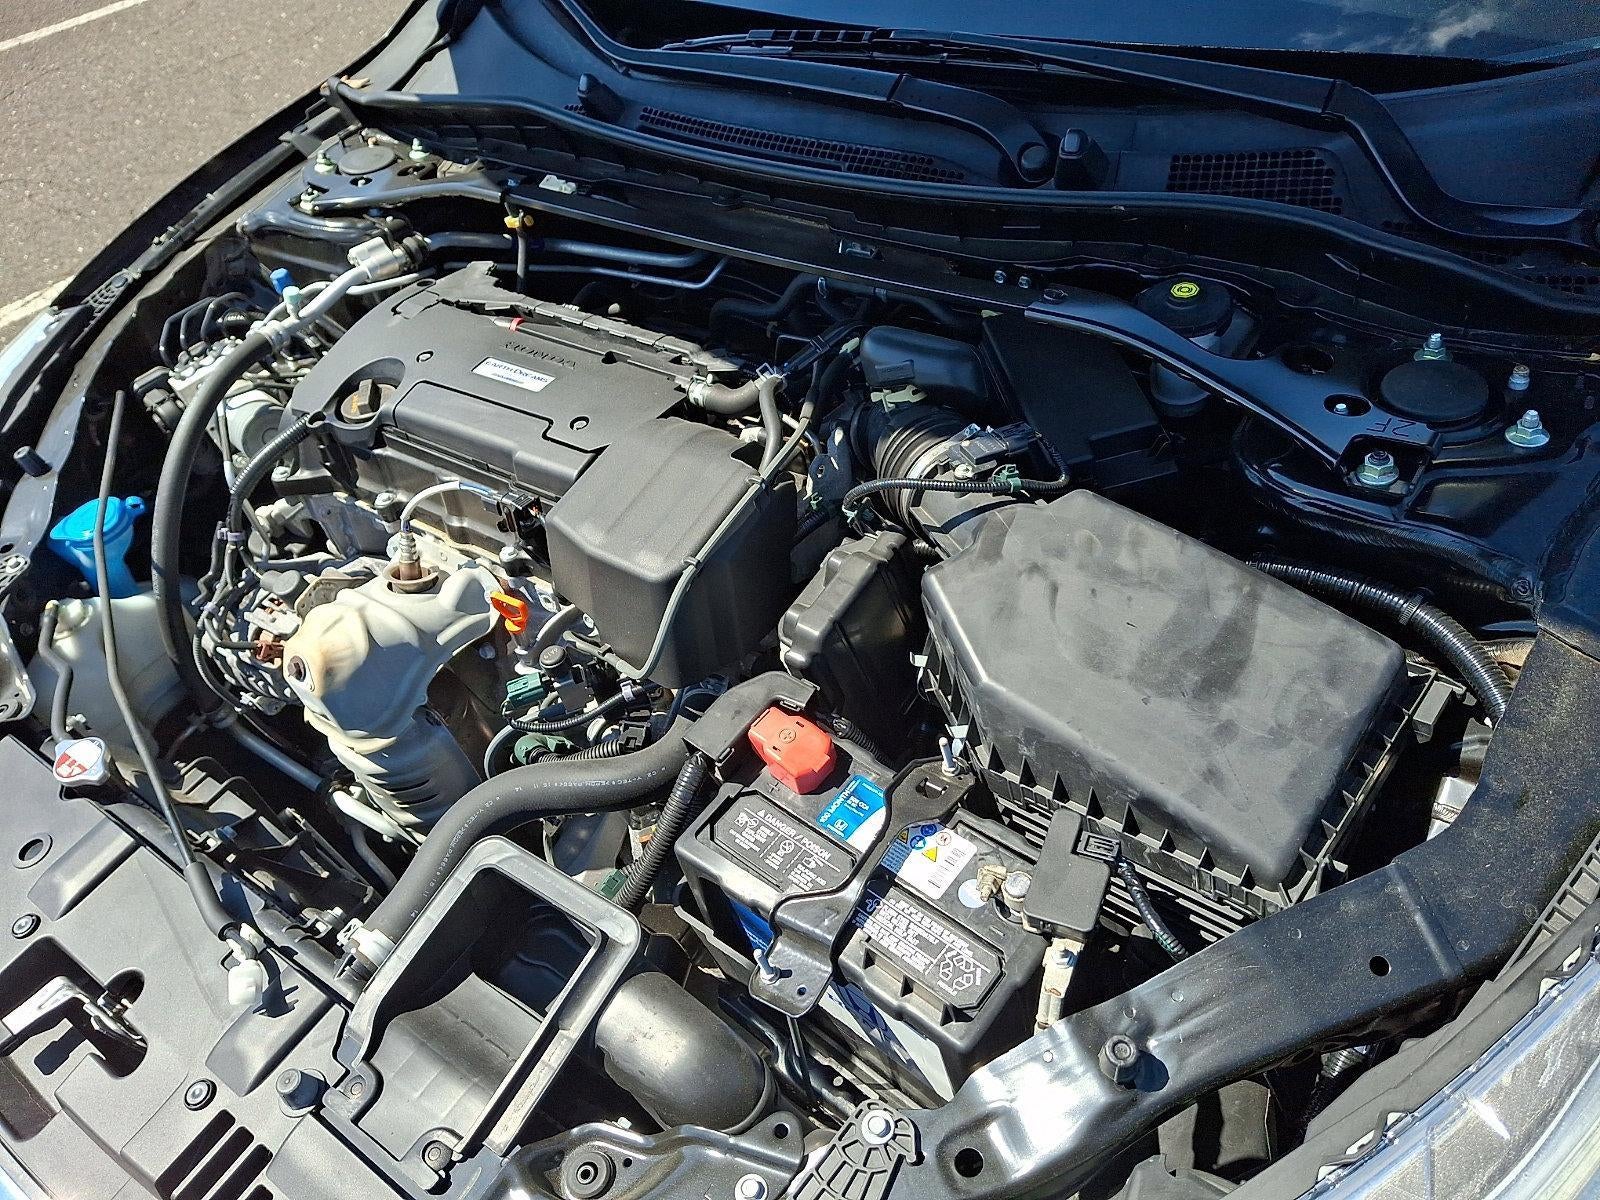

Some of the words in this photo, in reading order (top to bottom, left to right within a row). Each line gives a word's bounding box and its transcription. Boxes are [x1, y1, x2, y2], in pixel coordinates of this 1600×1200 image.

[829, 791, 851, 814] MONTH
[764, 814, 797, 838] DANGER
[800, 837, 832, 861] POISON
